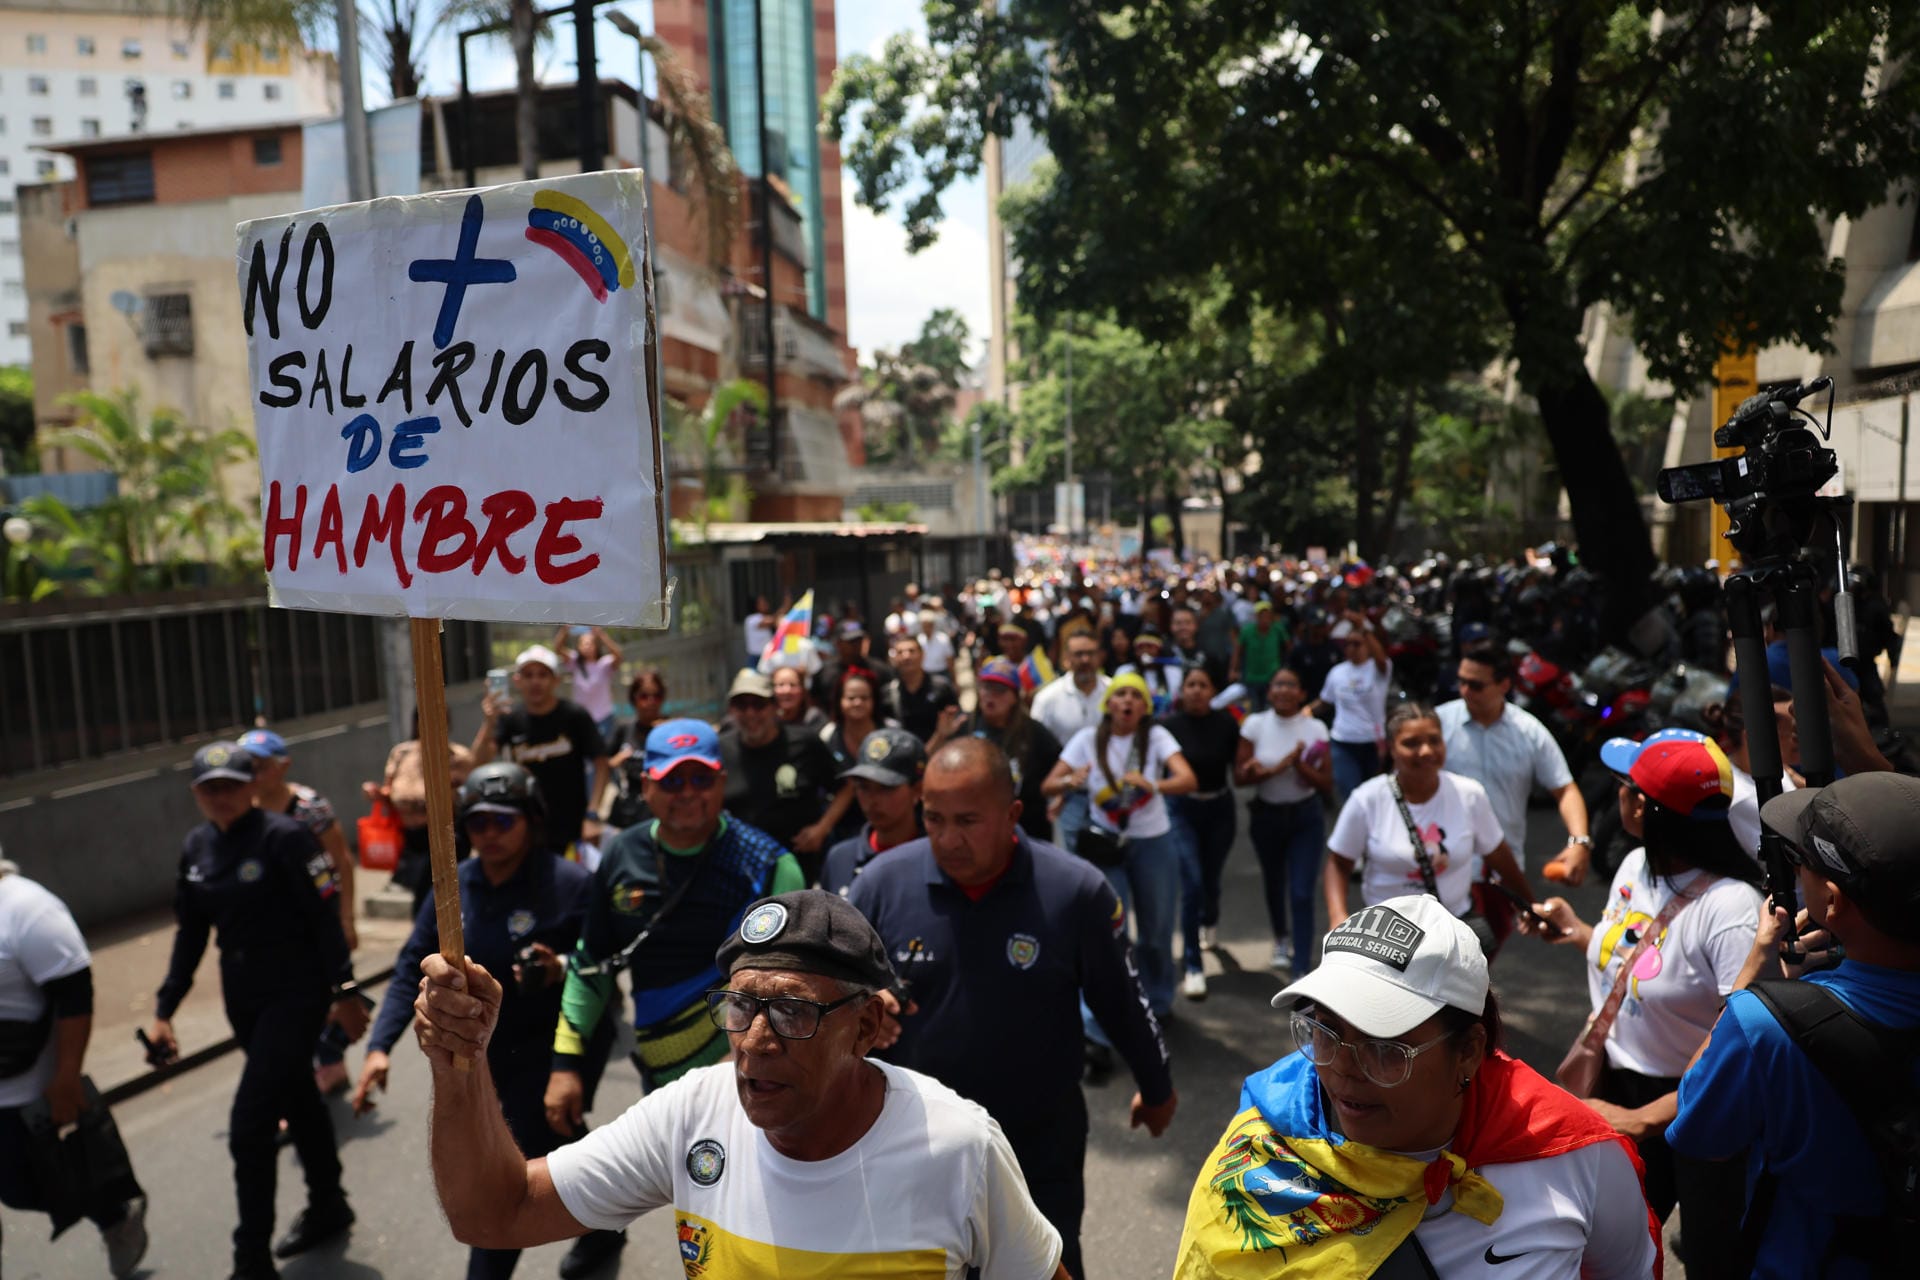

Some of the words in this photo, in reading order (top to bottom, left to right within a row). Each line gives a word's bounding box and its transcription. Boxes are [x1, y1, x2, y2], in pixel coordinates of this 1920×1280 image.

[244, 222, 334, 339] NO
[259, 338, 610, 428] SALARIOS
[341, 413, 441, 473] DE
[264, 480, 603, 588] HAMBRE
[1327, 936, 1363, 948] TACTICAL
[1365, 941, 1407, 964] SERIES
